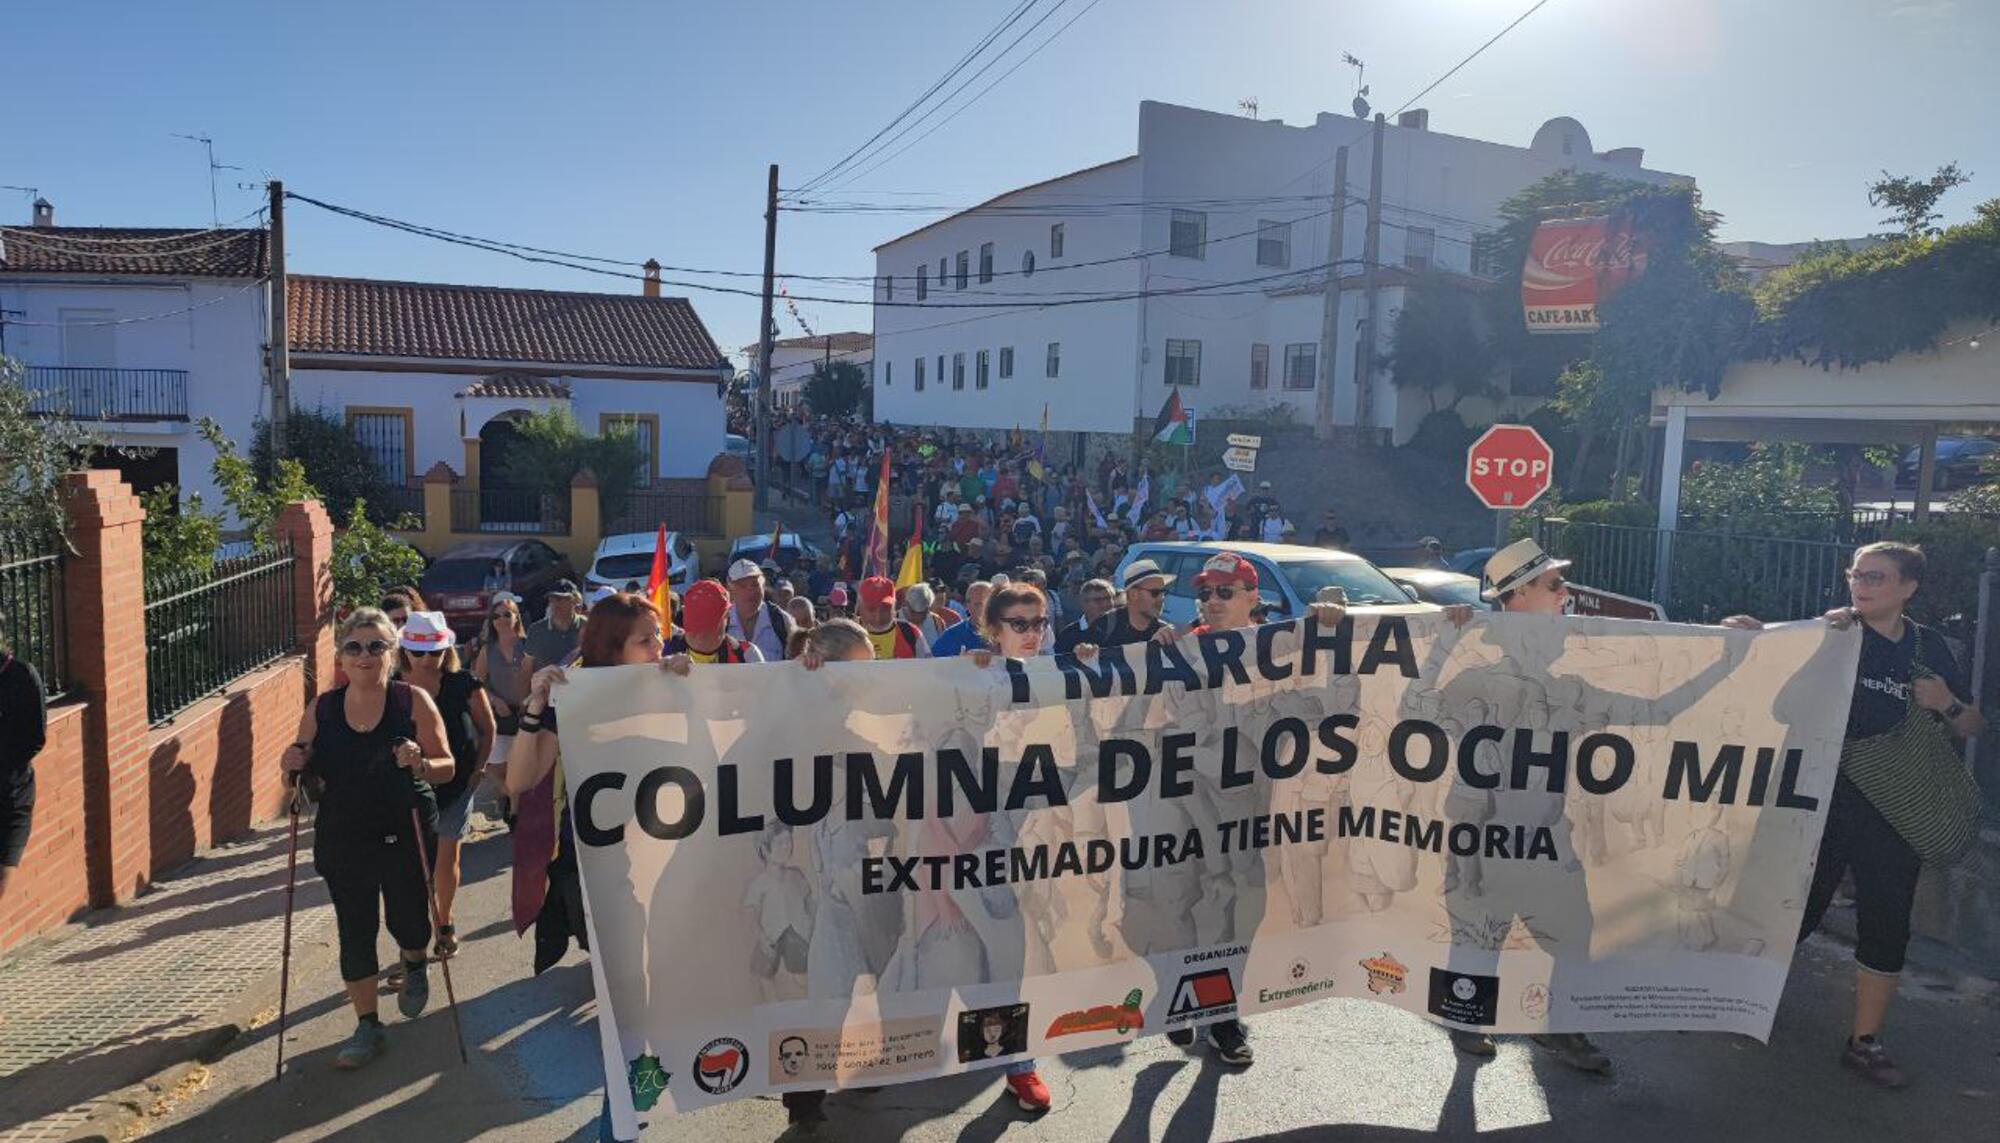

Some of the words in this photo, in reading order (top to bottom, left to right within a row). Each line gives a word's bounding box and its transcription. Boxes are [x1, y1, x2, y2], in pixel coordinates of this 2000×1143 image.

[1473, 457, 1547, 478] STOP
[1054, 614, 1420, 699] MARCHA
[572, 743, 1069, 847] COLUMNA
[1097, 730, 1196, 803] DE
[1219, 713, 1360, 790] LOS
[1387, 717, 1636, 795] OCHO
[1661, 740, 1819, 812] MIL
[861, 827, 1205, 895] EXTREMADURA
[1216, 807, 1326, 854] TIENE
[1337, 806, 1559, 861] MEMORIA
